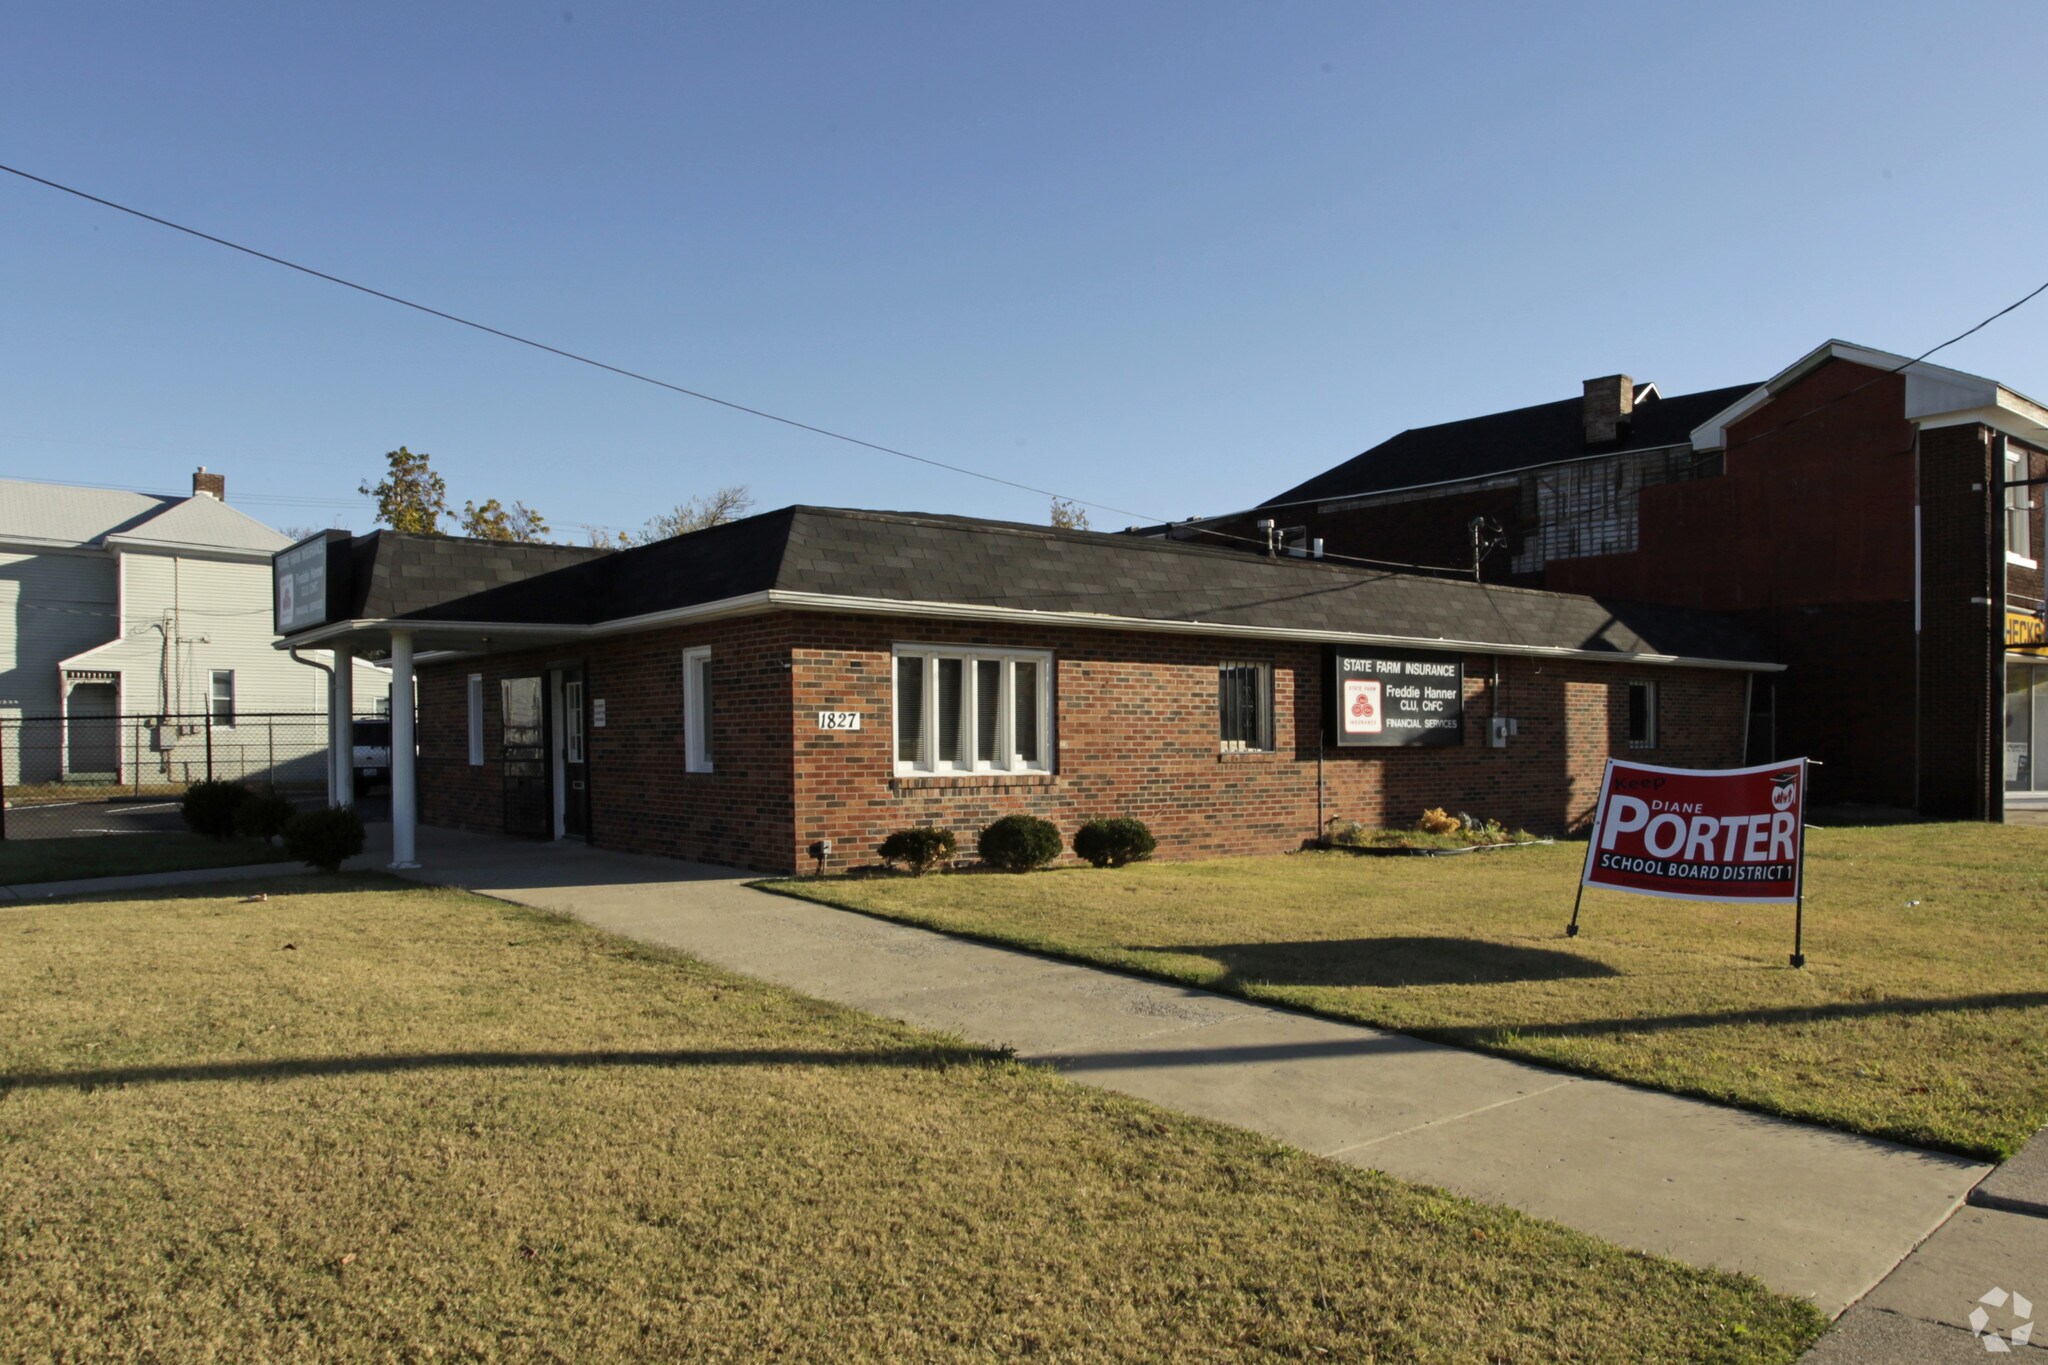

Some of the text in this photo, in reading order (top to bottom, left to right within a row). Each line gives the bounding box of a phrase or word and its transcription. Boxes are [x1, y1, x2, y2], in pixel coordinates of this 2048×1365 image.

[2006, 618, 2042, 645] HECKS
[1343, 658, 1455, 677] STATE FARM INSURANCE
[1386, 684, 1457, 700] Freddie Hanner
[1400, 699, 1443, 713] CLU, ChFC
[821, 712, 857, 729] 1827
[1386, 718, 1458, 729] FINANCIAL SERVICES
[1614, 776, 1667, 791] Keep
[1651, 799, 1704, 814] DIANE
[1600, 794, 1796, 862] PORTER
[1600, 853, 1792, 881] SCHOOL BOARD DISTRICT 1
